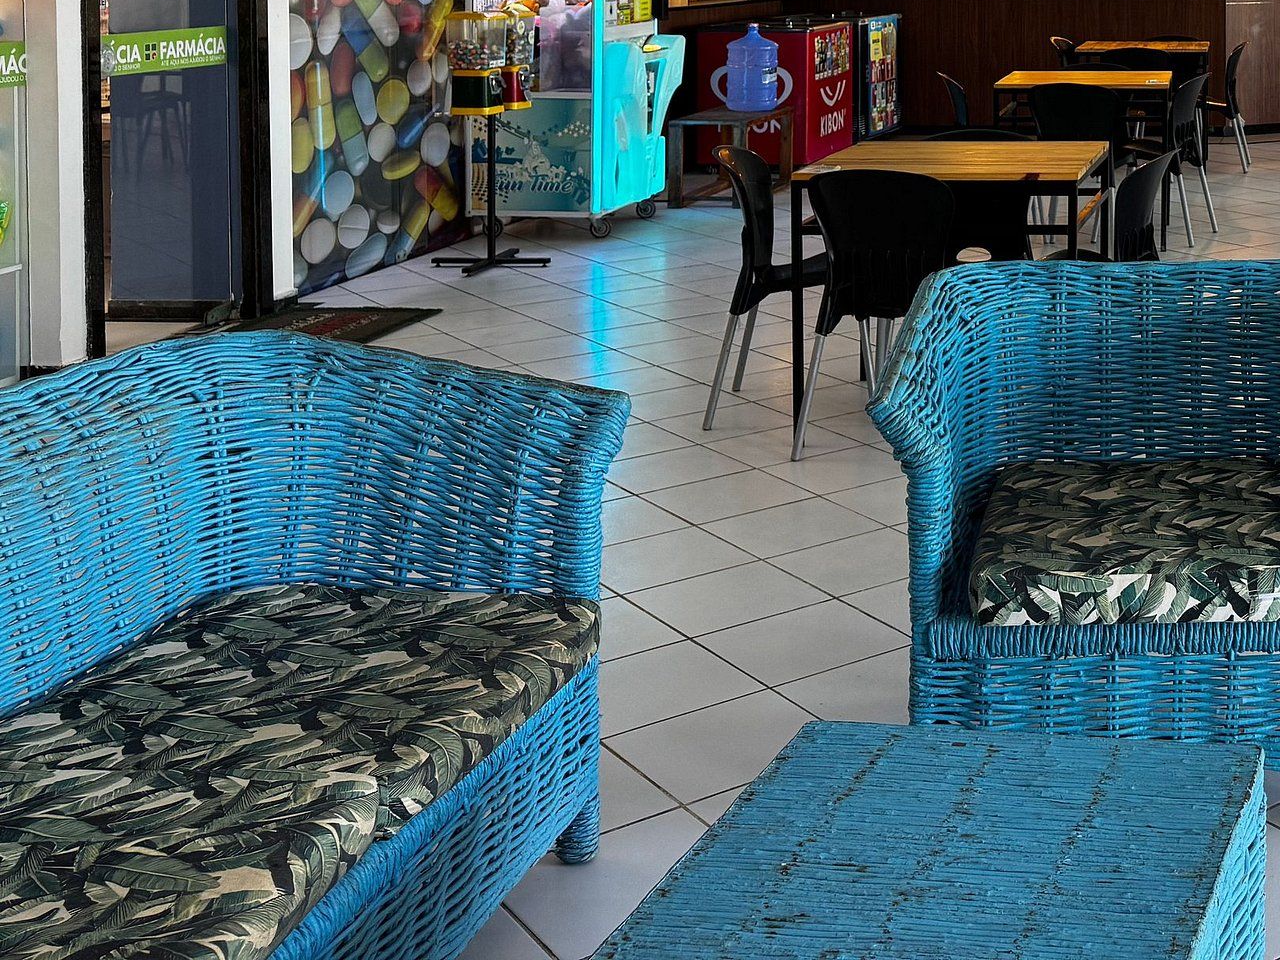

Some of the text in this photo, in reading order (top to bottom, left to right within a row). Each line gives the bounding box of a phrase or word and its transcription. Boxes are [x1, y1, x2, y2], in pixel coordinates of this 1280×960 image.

[159, 33, 227, 60] FARMÁCIA
[820, 108, 844, 138] KIBON
[529, 173, 574, 193] Time
